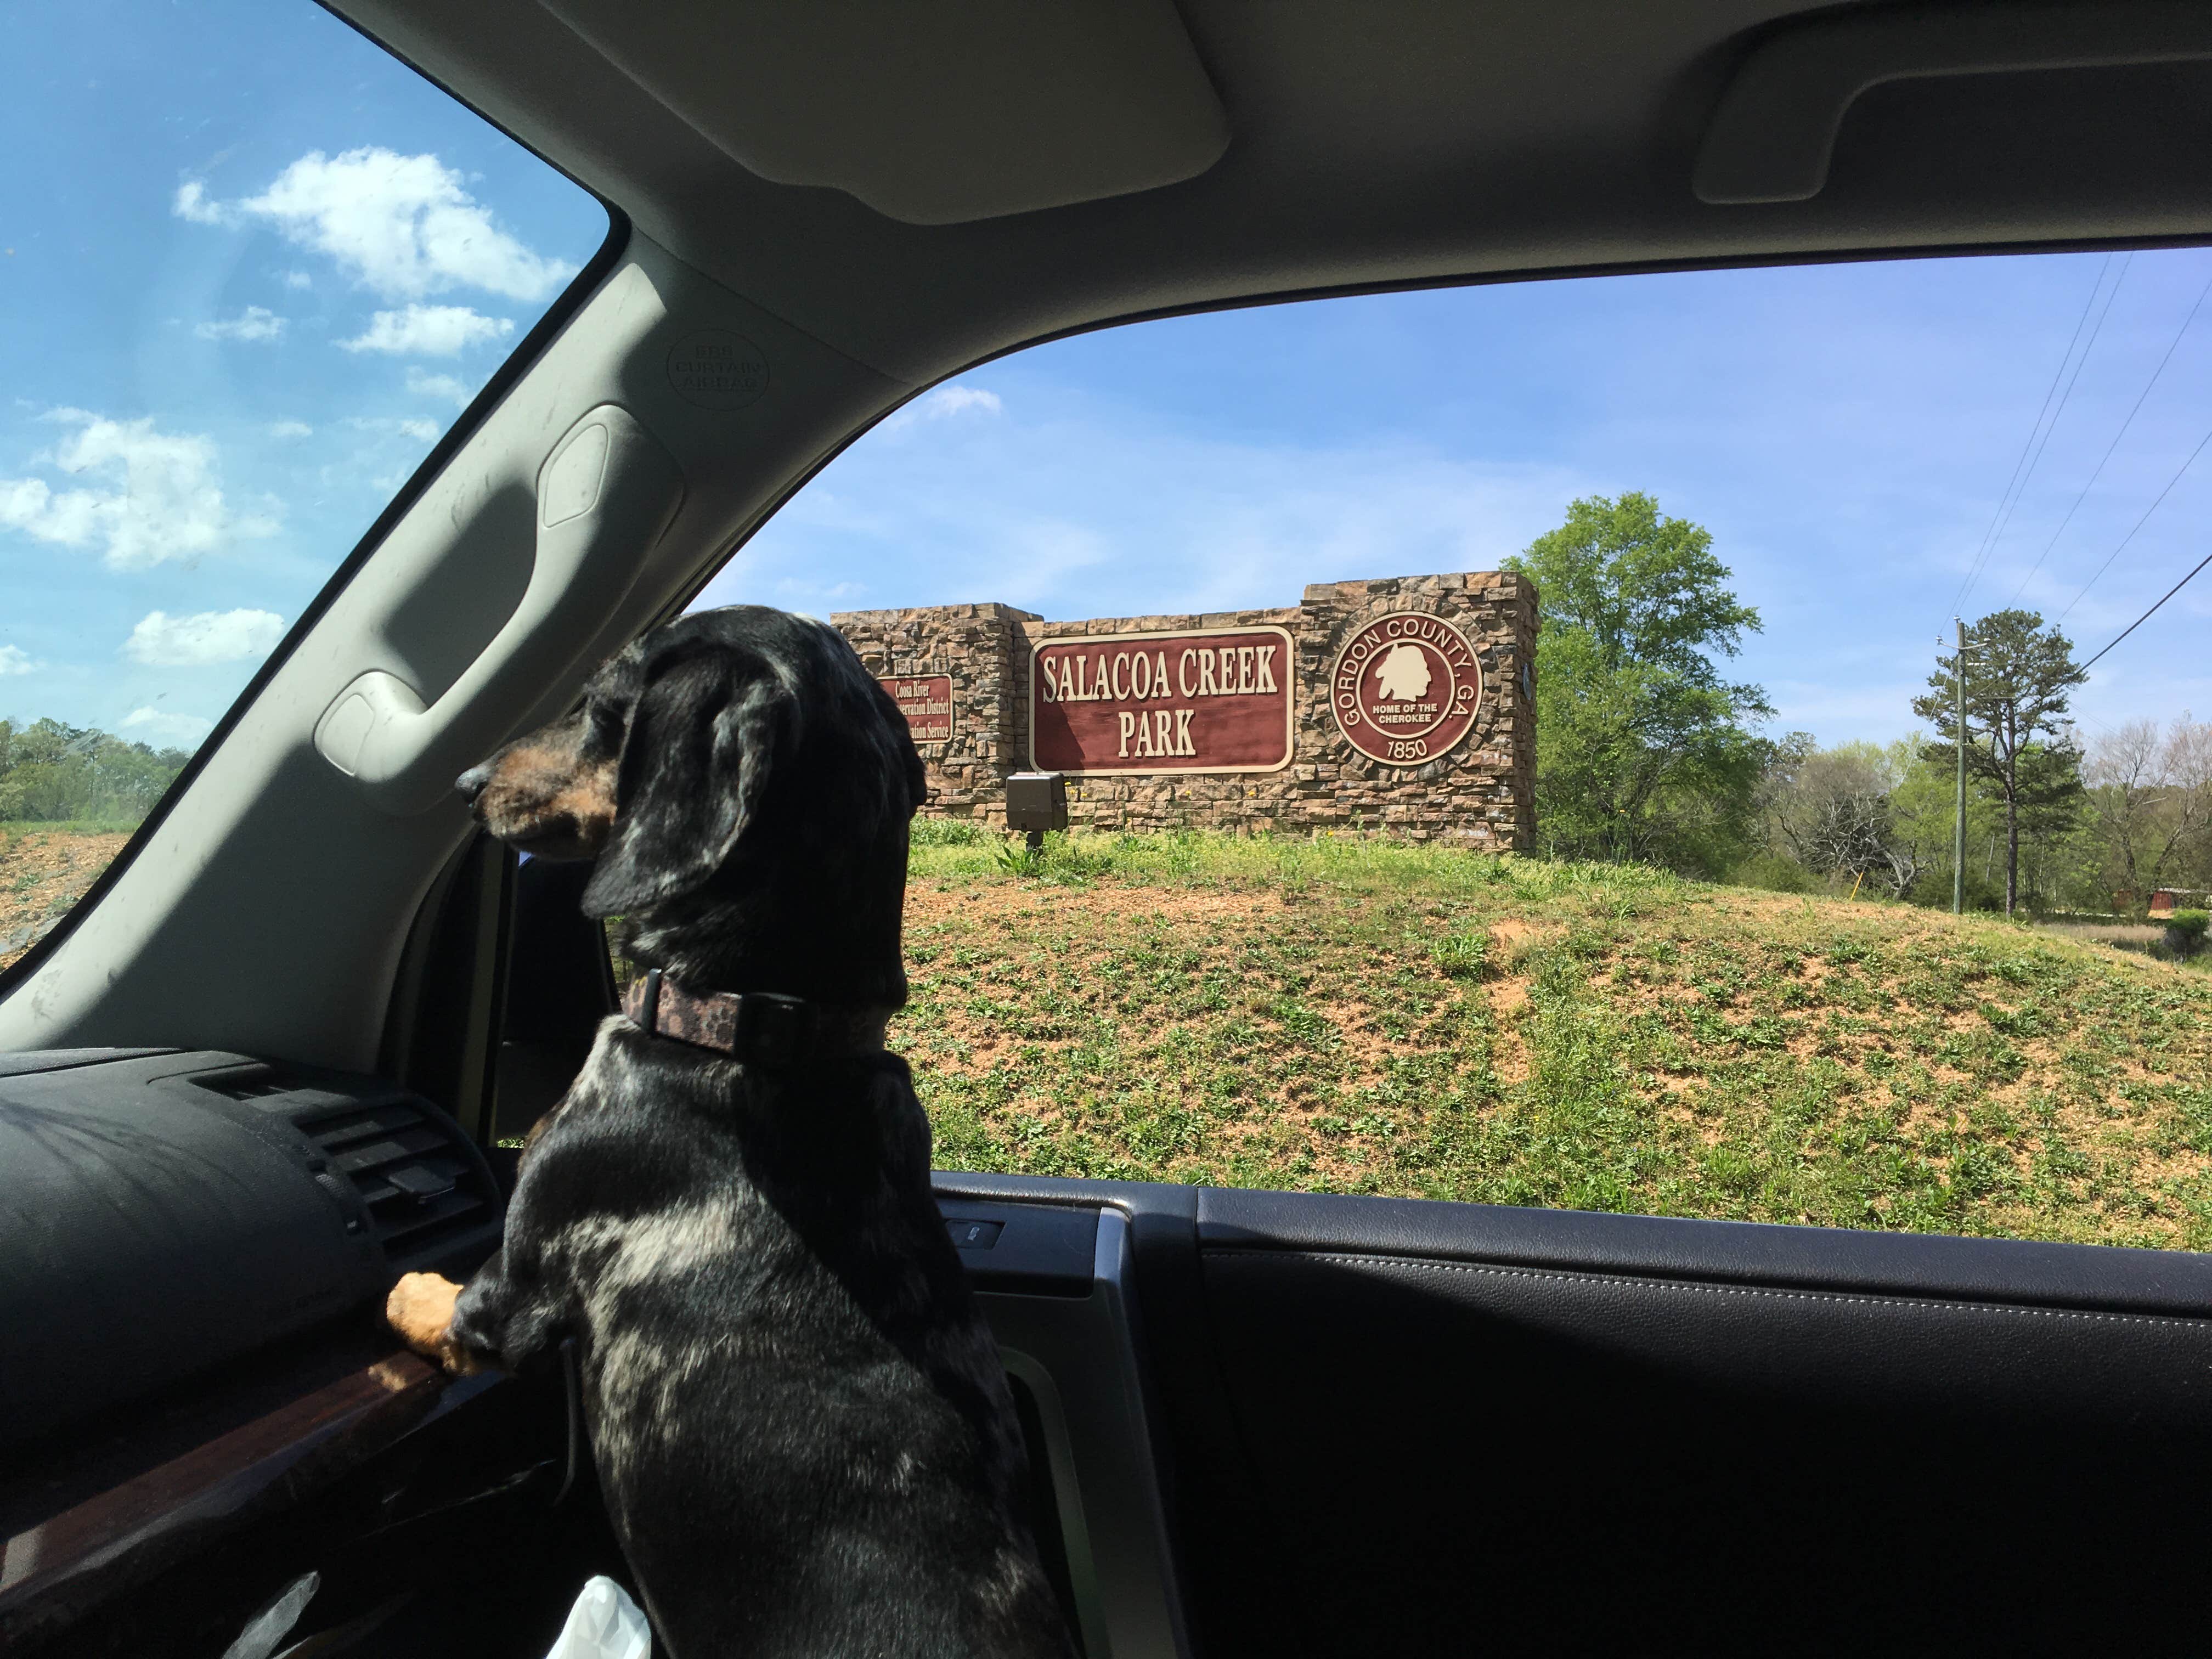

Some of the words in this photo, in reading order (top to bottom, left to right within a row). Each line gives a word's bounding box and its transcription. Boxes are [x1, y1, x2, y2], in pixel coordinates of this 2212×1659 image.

[1043, 651, 1172, 703] SALACOA
[1178, 645, 1278, 698] CREEK
[1339, 629, 1381, 726] GORDON
[1448, 685, 1475, 720] GA.
[895, 681, 912, 698] Coosa
[913, 680, 929, 697] River
[899, 698, 926, 715] servation
[927, 697, 949, 714] District
[1373, 705, 1401, 714] HOME
[1403, 704, 1417, 713] OF
[1418, 703, 1437, 712] THE
[1379, 714, 1431, 724] CHEROKEE
[927, 720, 949, 738] Service
[1118, 709, 1197, 758] PARK
[1387, 738, 1427, 759] 1850
